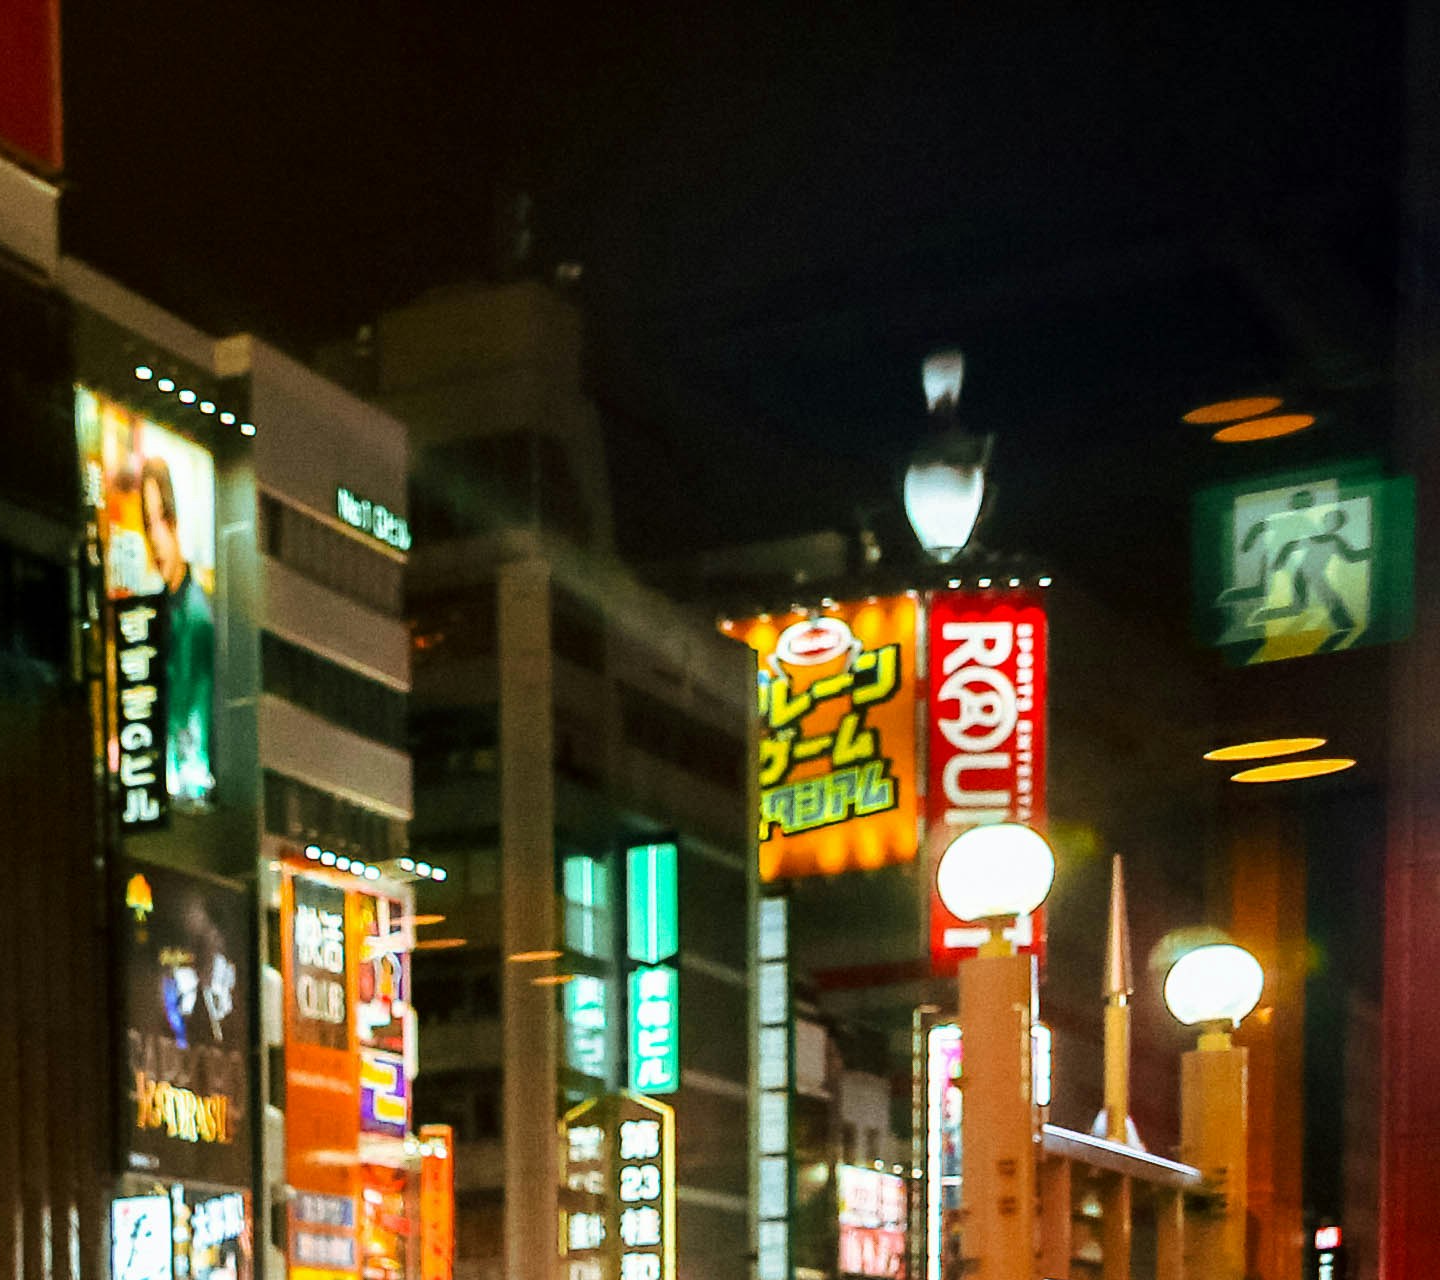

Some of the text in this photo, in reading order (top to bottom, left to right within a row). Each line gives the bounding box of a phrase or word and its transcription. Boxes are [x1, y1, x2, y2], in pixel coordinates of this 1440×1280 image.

[758, 643, 900, 727] レーン
[758, 762, 895, 841] タジアム
[1015, 718, 1033, 823] ENTERTA
